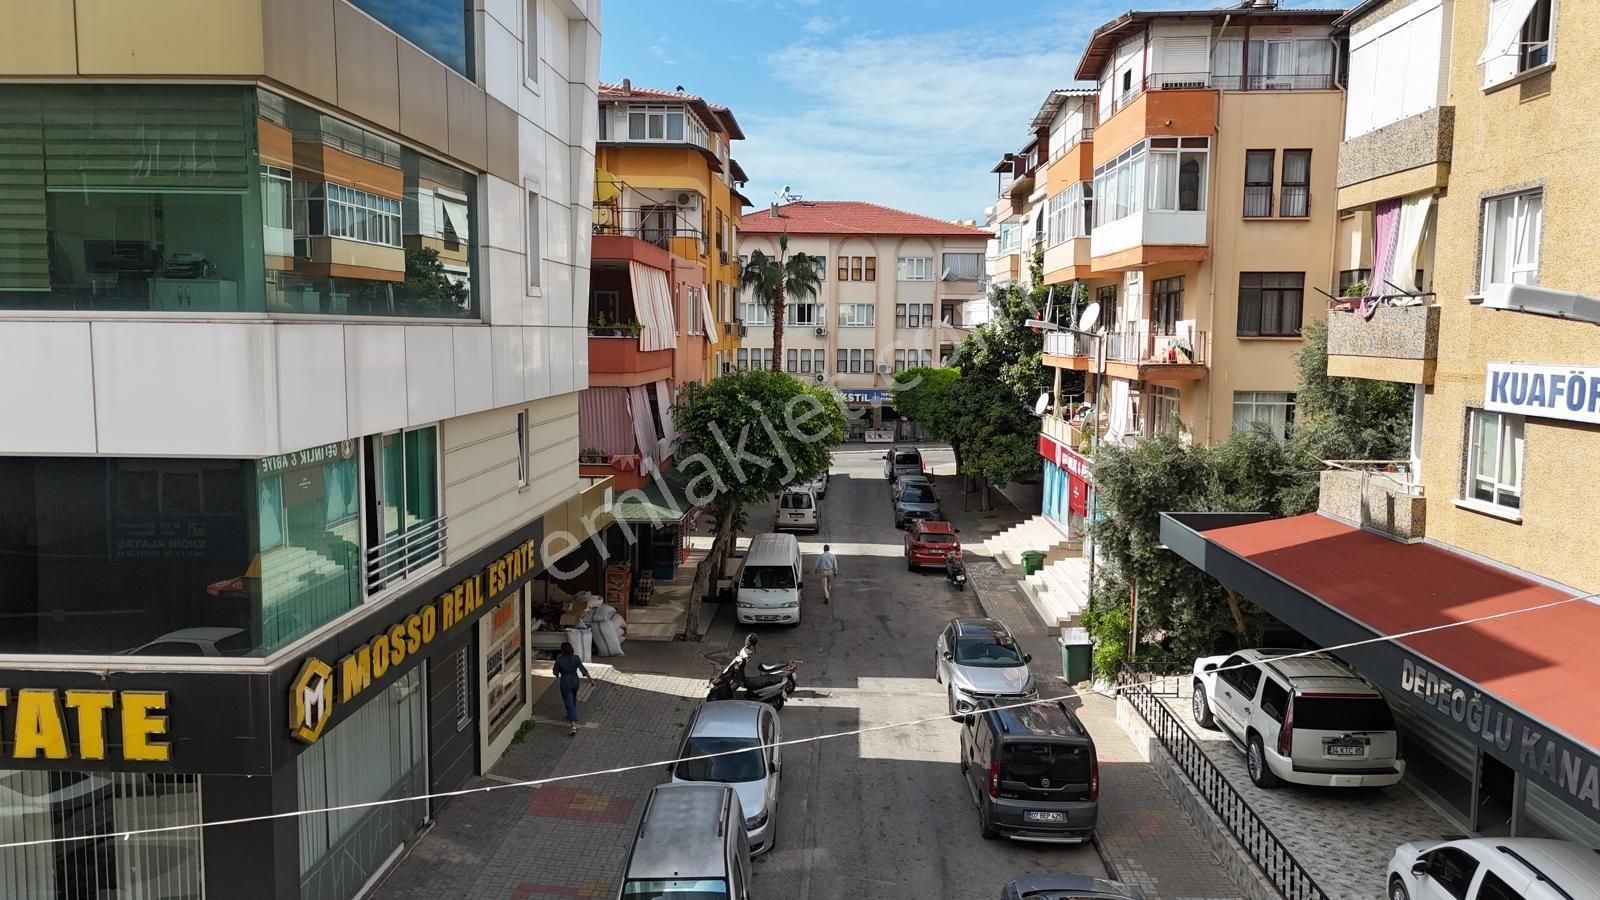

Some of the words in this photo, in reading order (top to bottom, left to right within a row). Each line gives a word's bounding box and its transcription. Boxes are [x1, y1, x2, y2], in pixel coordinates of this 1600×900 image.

[1490, 370, 1600, 413] KUAFÖR
[337, 603, 437, 705] MOSSO
[439, 574, 484, 632] REAL
[486, 538, 536, 596] ESTATE
[0, 688, 175, 762] ATE
[1401, 658, 1513, 752] DEDEOĞLU
[1519, 726, 1600, 810] KANA
